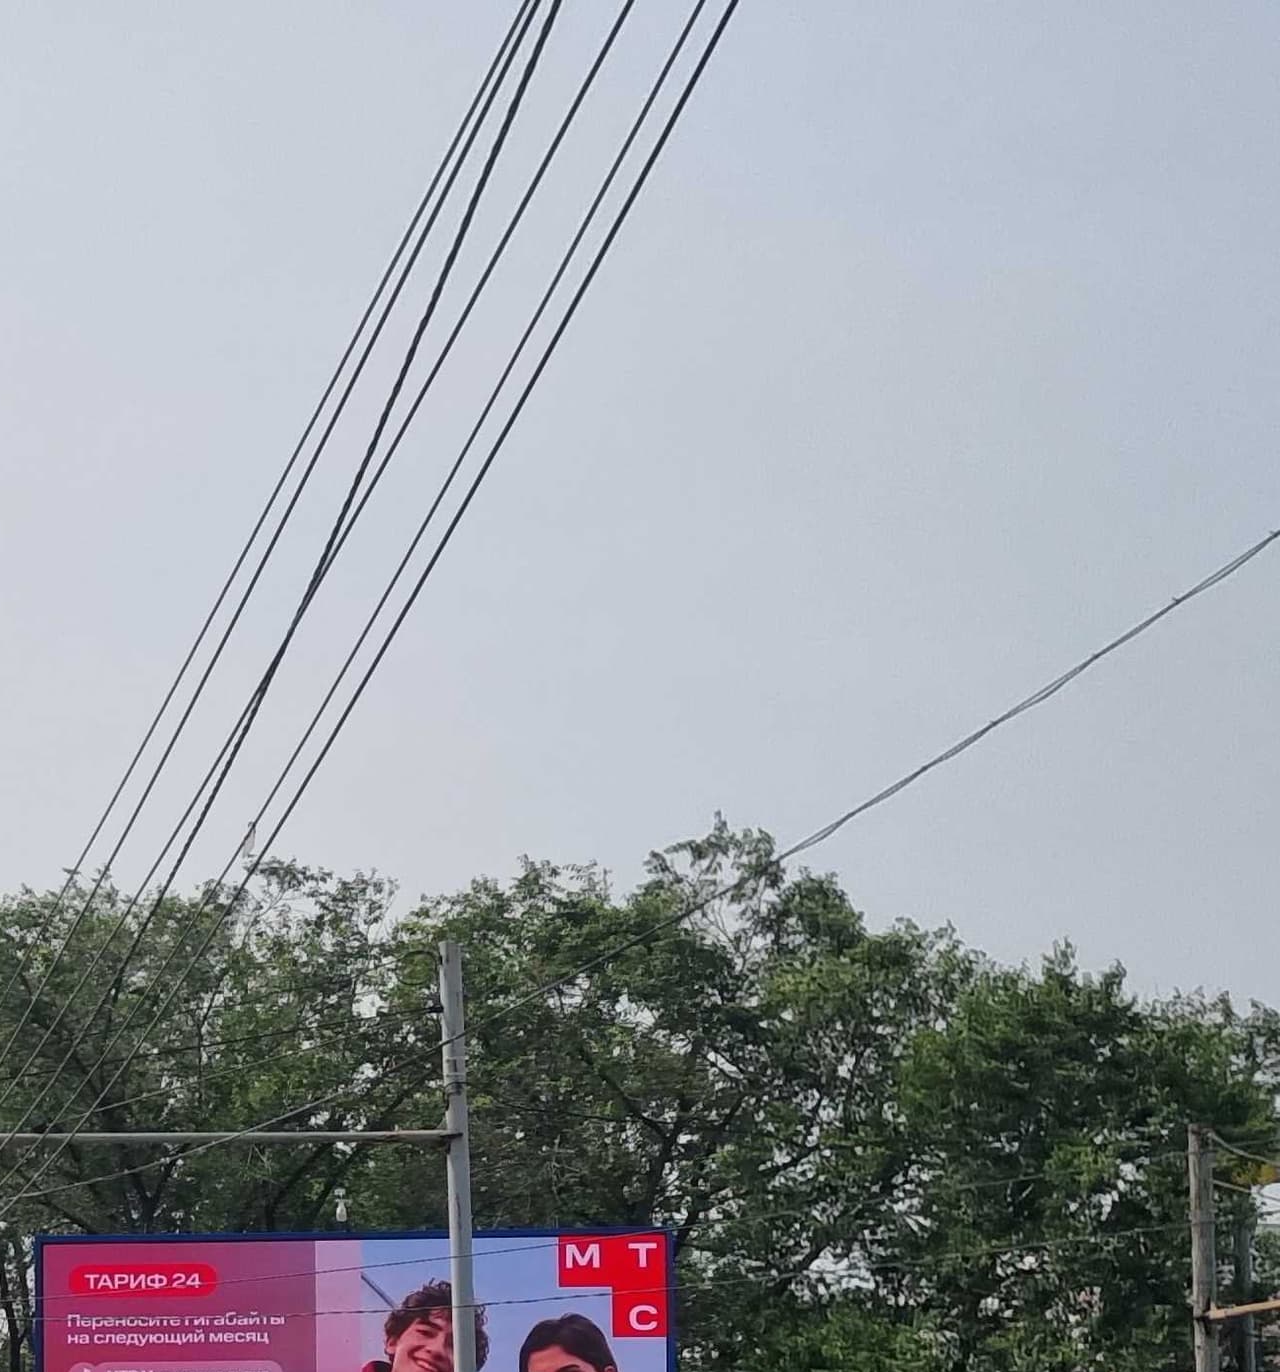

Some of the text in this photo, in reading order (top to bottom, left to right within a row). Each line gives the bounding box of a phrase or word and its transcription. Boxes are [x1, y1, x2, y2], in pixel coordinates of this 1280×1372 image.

[84, 1272, 203, 1290] ТАРИФ 24
[67, 1311, 285, 1330] Переносите гигабайты
[67, 1329, 270, 1346] на следующий месяц
